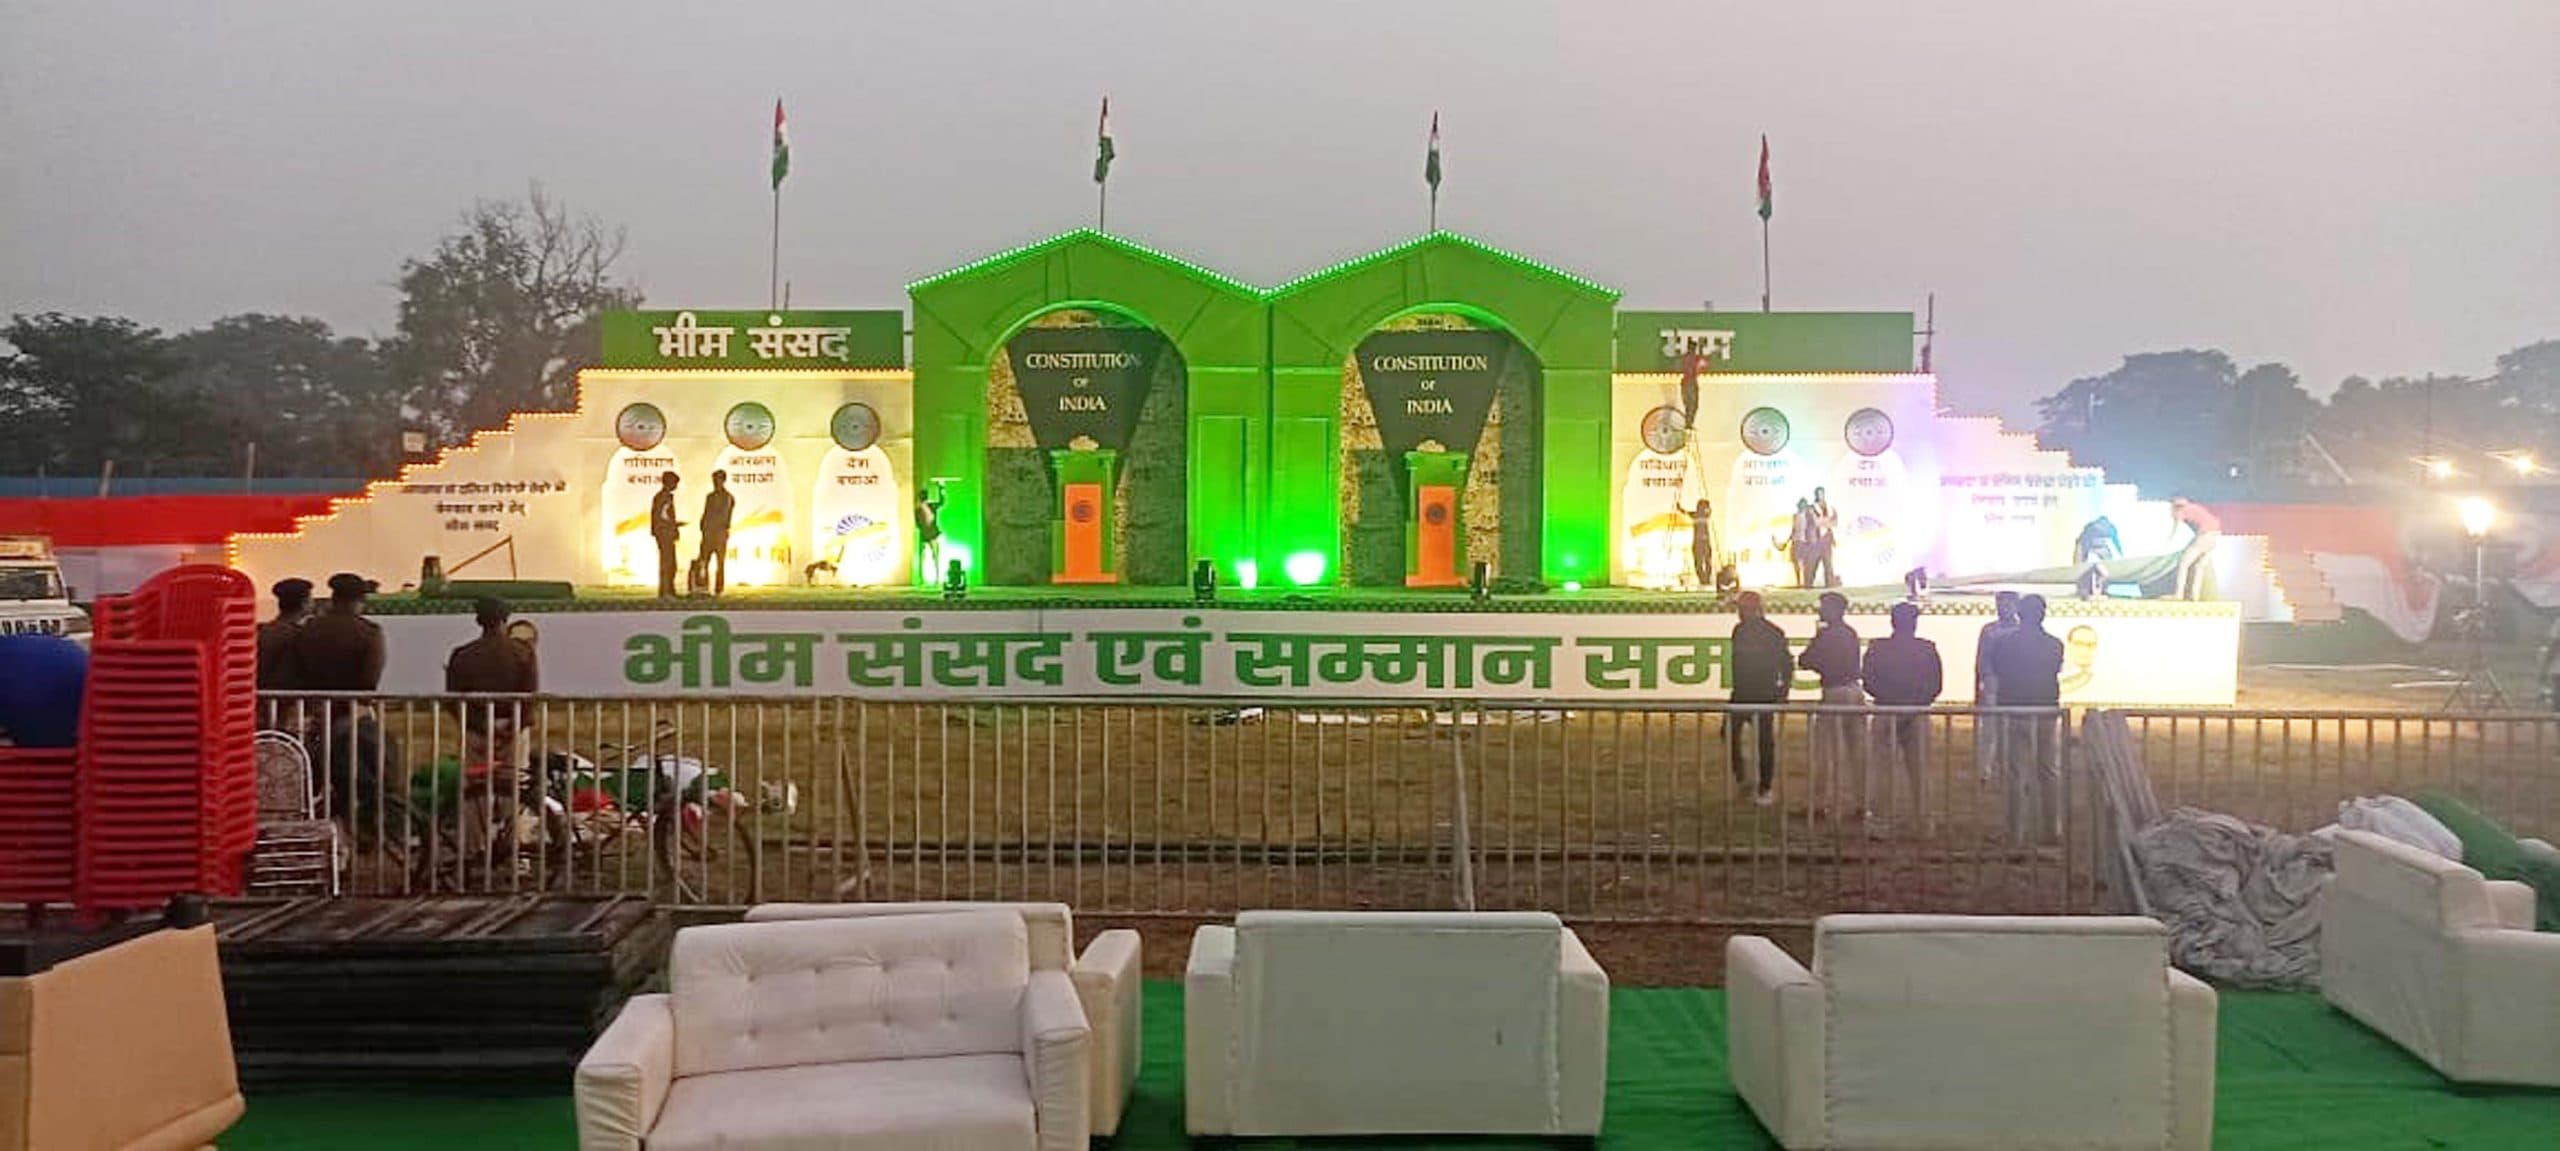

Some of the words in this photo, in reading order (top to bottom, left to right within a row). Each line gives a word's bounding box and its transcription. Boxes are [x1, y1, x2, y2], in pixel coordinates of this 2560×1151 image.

[653, 312, 734, 358] भीम
[747, 315, 851, 361] संसद
[1026, 352, 1141, 369] CONSTITUTION
[1373, 355, 1488, 371] CONSTITUTION
[1059, 396, 1107, 412] INDIA
[1406, 400, 1453, 415] INDIA
[624, 615, 823, 688] भीम
[837, 616, 1072, 688] संसद
[1086, 615, 1212, 687] एवं
[1226, 632, 1562, 690] सम्मान
